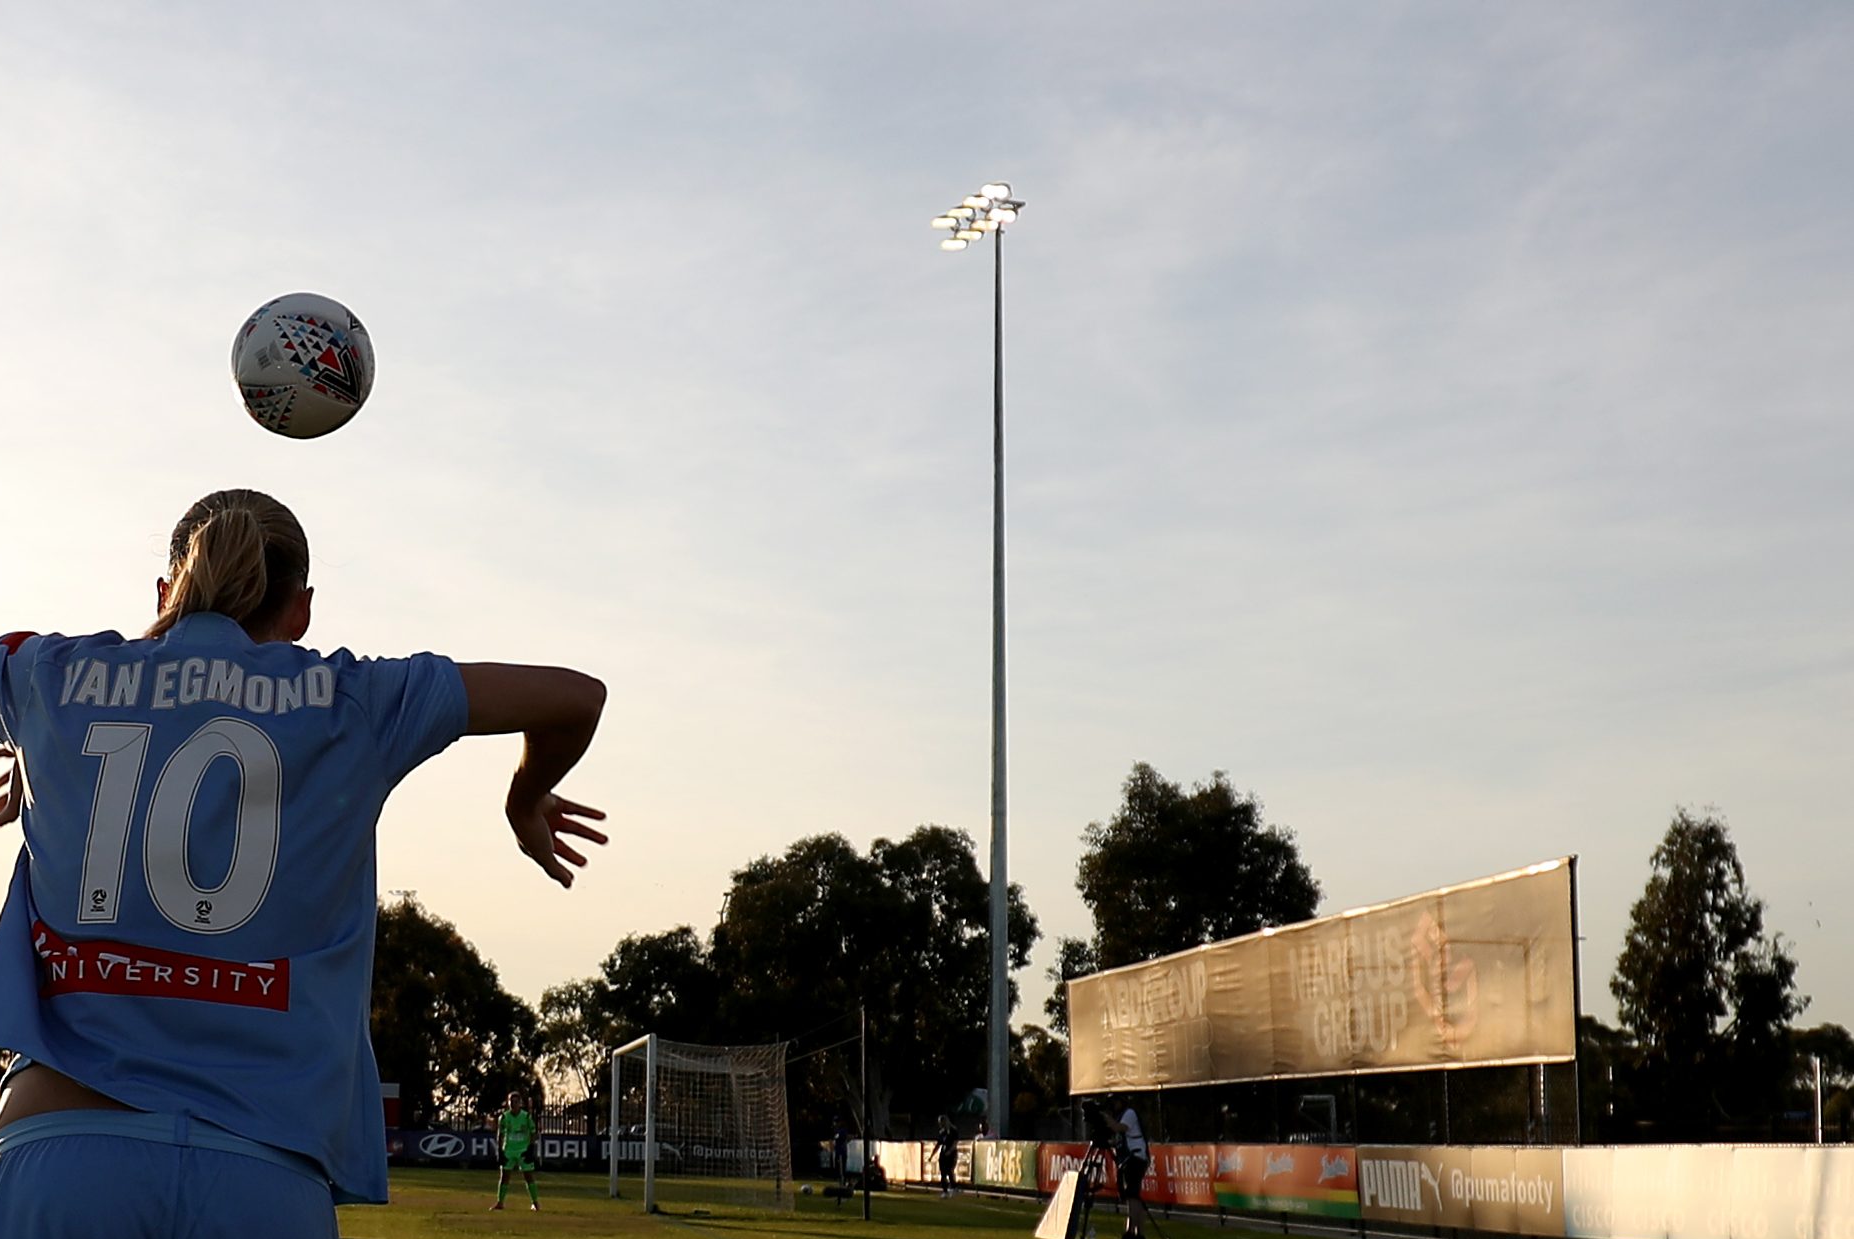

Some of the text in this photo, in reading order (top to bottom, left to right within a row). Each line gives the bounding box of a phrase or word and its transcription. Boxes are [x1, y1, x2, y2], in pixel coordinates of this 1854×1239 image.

[59, 657, 336, 716] VAN EGMOND
[77, 716, 283, 935] 10
[49, 959, 275, 996] NIVERSITY
[1289, 928, 1405, 1001] MARCUS
[1314, 990, 1407, 1057] GROUP
[471, 1138, 588, 1159] HYDAI
[1361, 1160, 1422, 1210] PUMA
[1451, 1169, 1554, 1214] @pumafooty
[1572, 1206, 1615, 1229] CISCO
